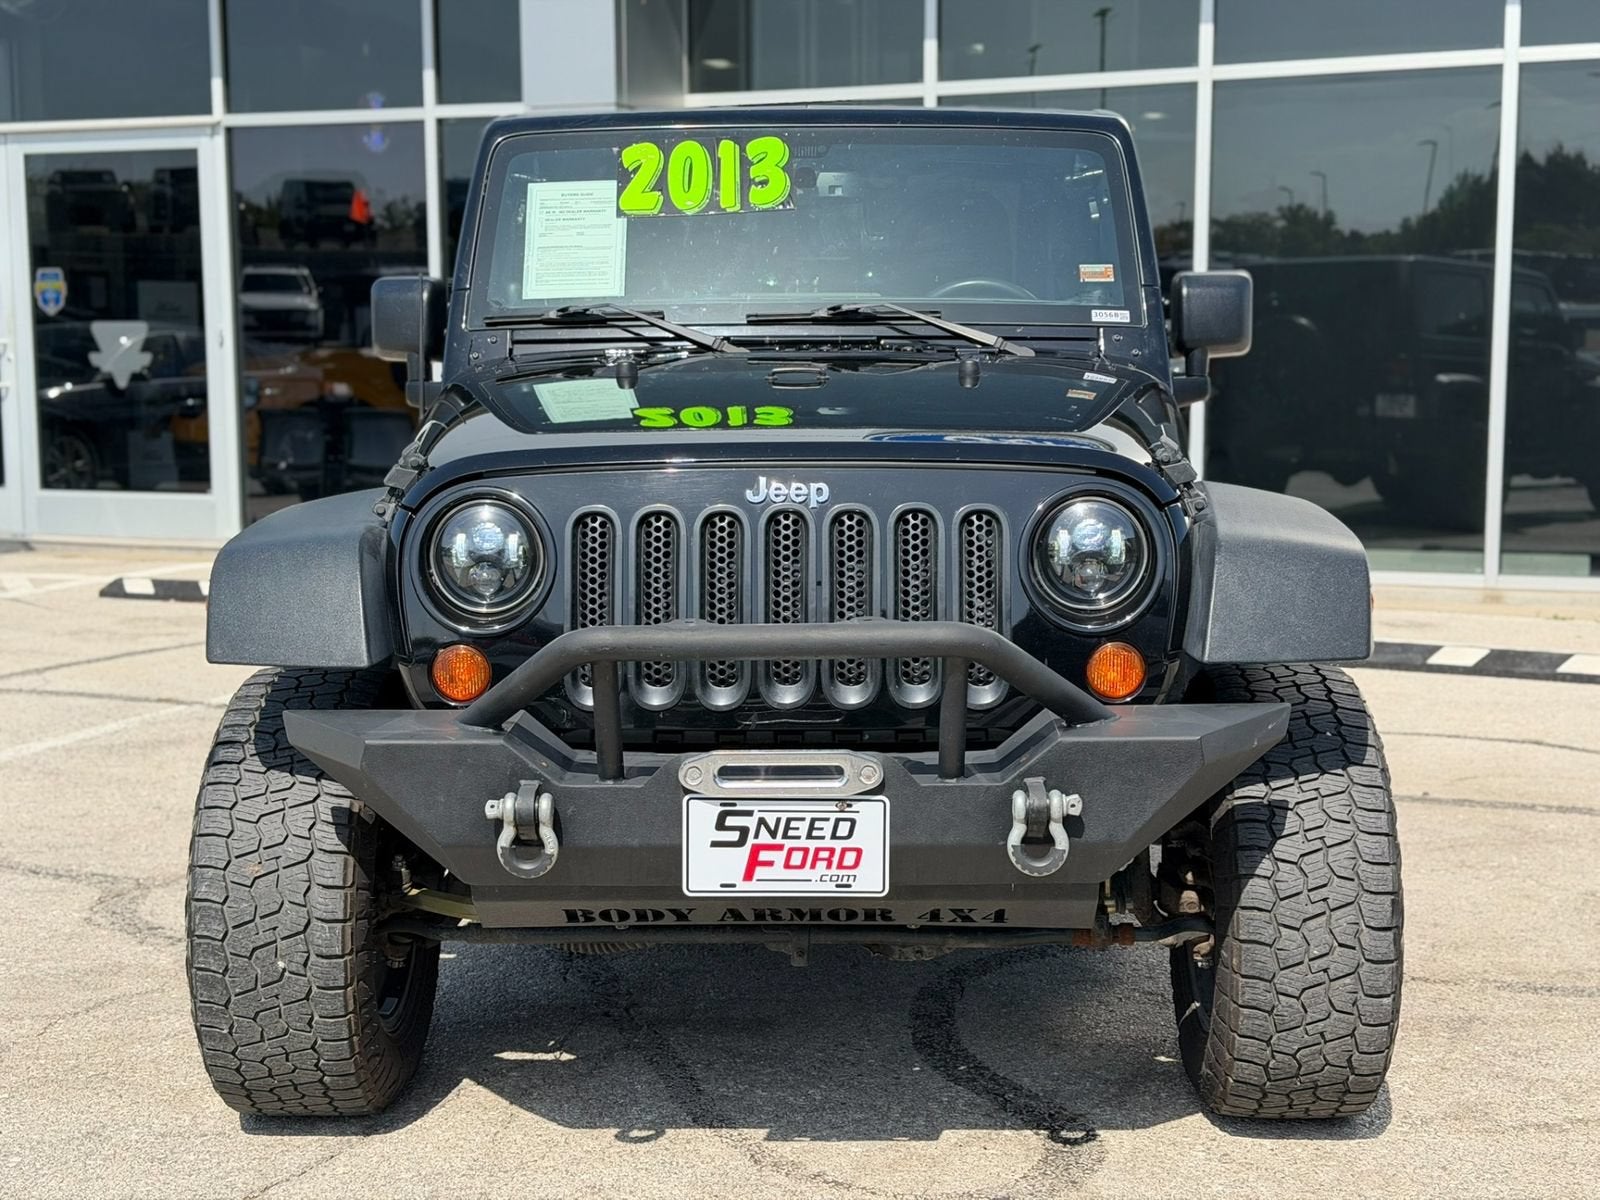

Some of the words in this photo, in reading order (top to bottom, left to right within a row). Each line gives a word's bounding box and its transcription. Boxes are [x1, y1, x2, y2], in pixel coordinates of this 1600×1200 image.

[619, 136, 792, 216] 2013
[745, 476, 830, 509] Jeep
[709, 809, 857, 848] SNEED
[742, 843, 863, 882] FORD
[814, 873, 857, 883] .com
[562, 907, 696, 924] BODY
[717, 907, 895, 923] ARMOR
[916, 907, 1009, 923] 4X4
